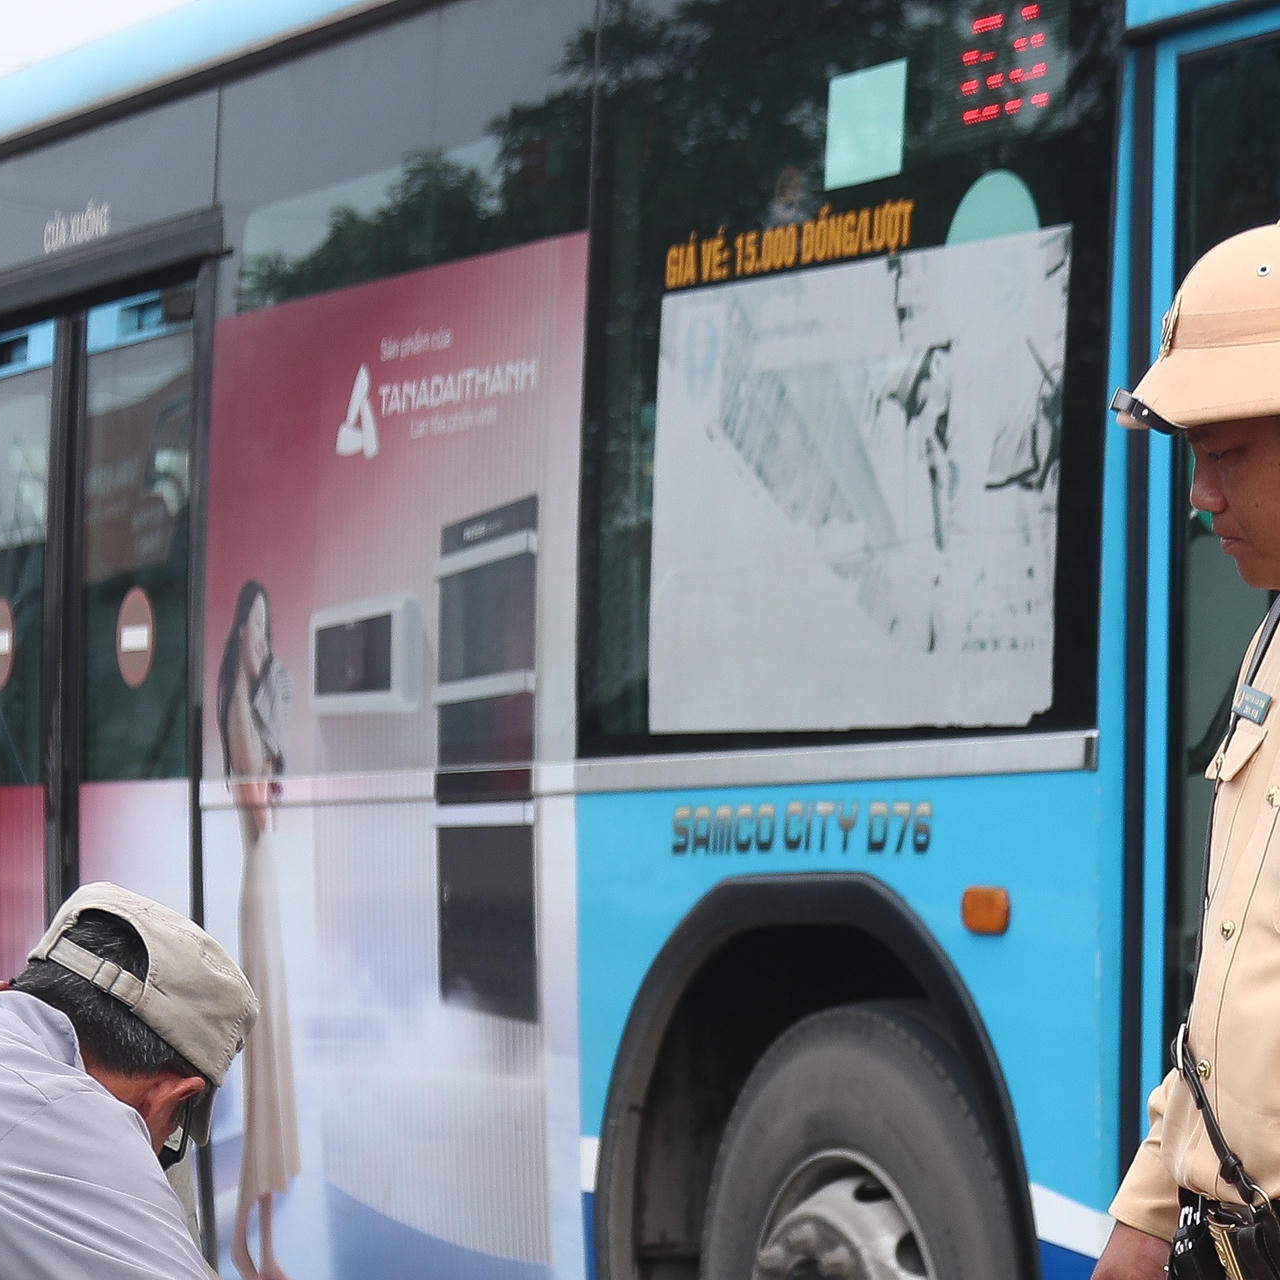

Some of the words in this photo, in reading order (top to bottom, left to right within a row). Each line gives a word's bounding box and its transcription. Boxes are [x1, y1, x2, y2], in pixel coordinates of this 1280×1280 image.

[664, 229, 699, 290] GIÁ
[734, 222, 798, 278] 15.000
[671, 803, 777, 857] SAMCO
[783, 799, 860, 854] CITY
